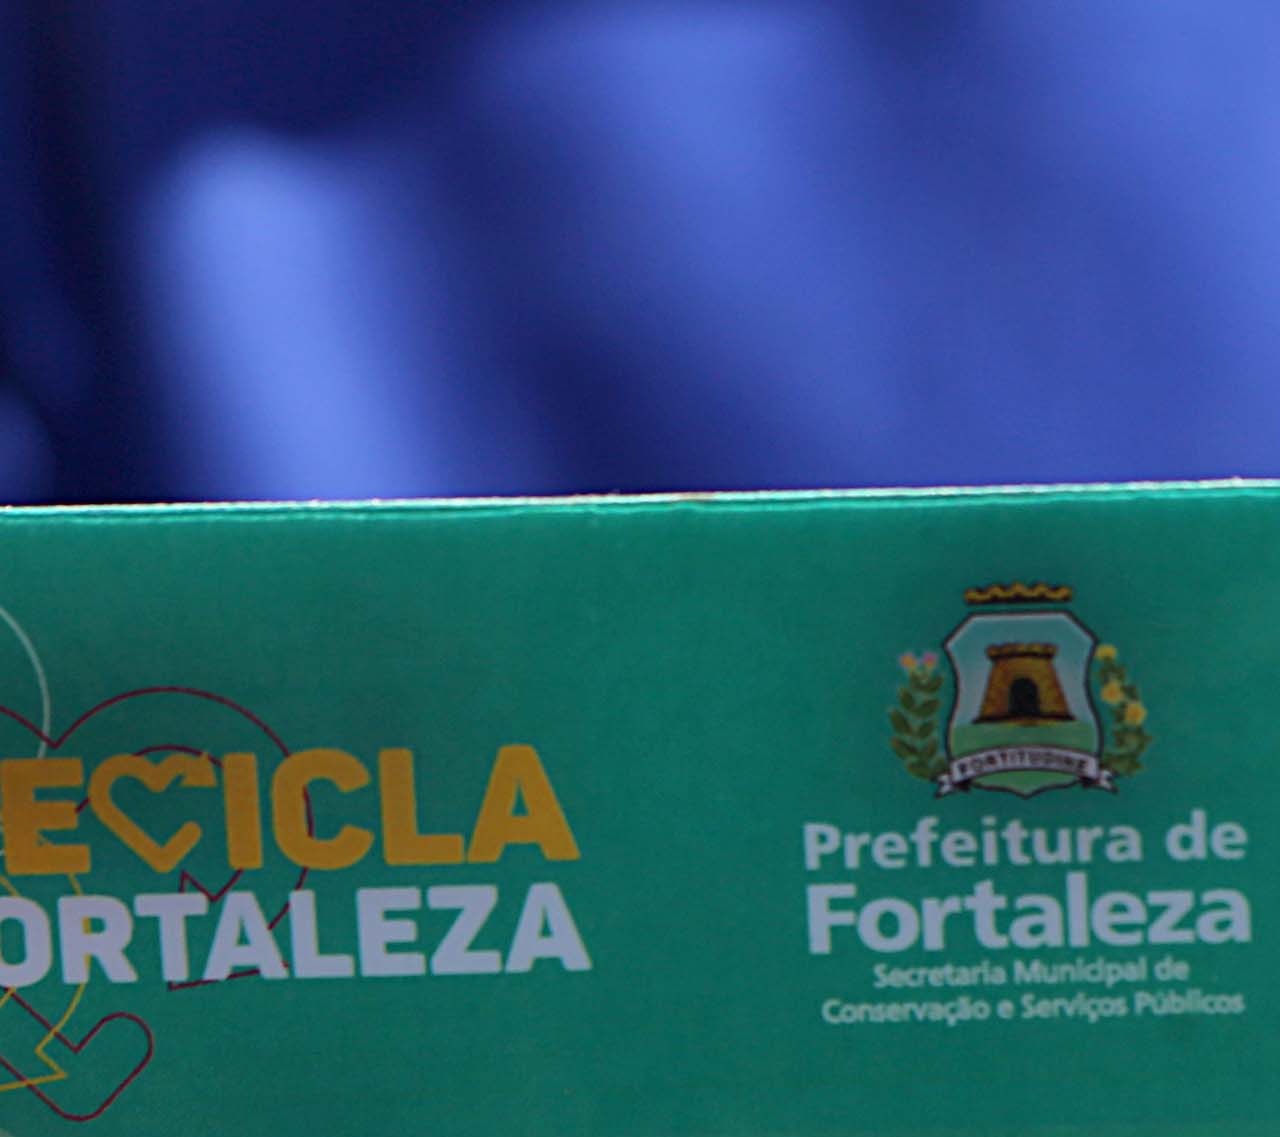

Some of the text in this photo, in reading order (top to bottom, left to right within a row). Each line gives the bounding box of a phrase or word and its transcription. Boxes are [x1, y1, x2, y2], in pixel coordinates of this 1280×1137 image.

[803, 808, 1248, 870] Prefeitura de
[806, 873, 1252, 954] Fortaleza
[874, 959, 1189, 988] Secretaria Municipal de
[822, 989, 1246, 1026] Conservação e Serviços Públicos
